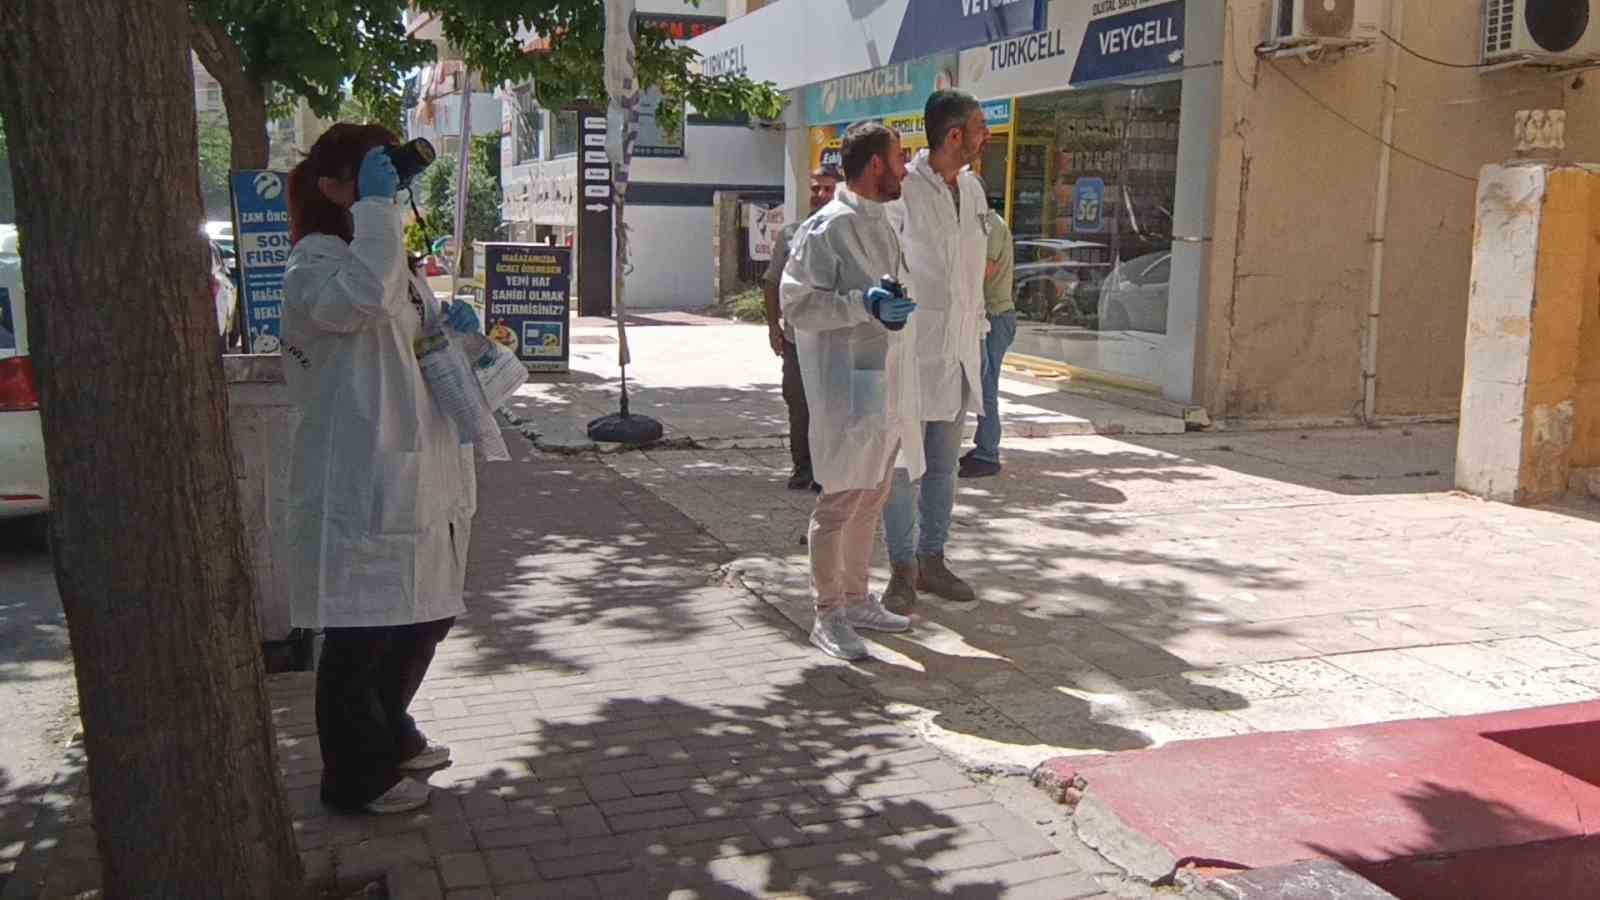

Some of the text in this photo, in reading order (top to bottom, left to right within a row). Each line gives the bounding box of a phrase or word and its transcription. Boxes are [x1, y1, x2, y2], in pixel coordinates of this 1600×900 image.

[1099, 17, 1178, 55] VEYCELL
[990, 29, 1064, 71] TURKCELL
[838, 63, 912, 101] TURKCELL
[242, 213, 264, 223] ZAM
[257, 235, 290, 248] SON
[246, 251, 288, 265] FIRS
[496, 264, 521, 273] ÜCRET
[505, 275, 551, 286] YENİ HAT
[492, 288, 526, 300] SAHİBİ
[529, 290, 564, 301] OLMAK
[491, 304, 565, 315] İSTERMİSİNİZ?
